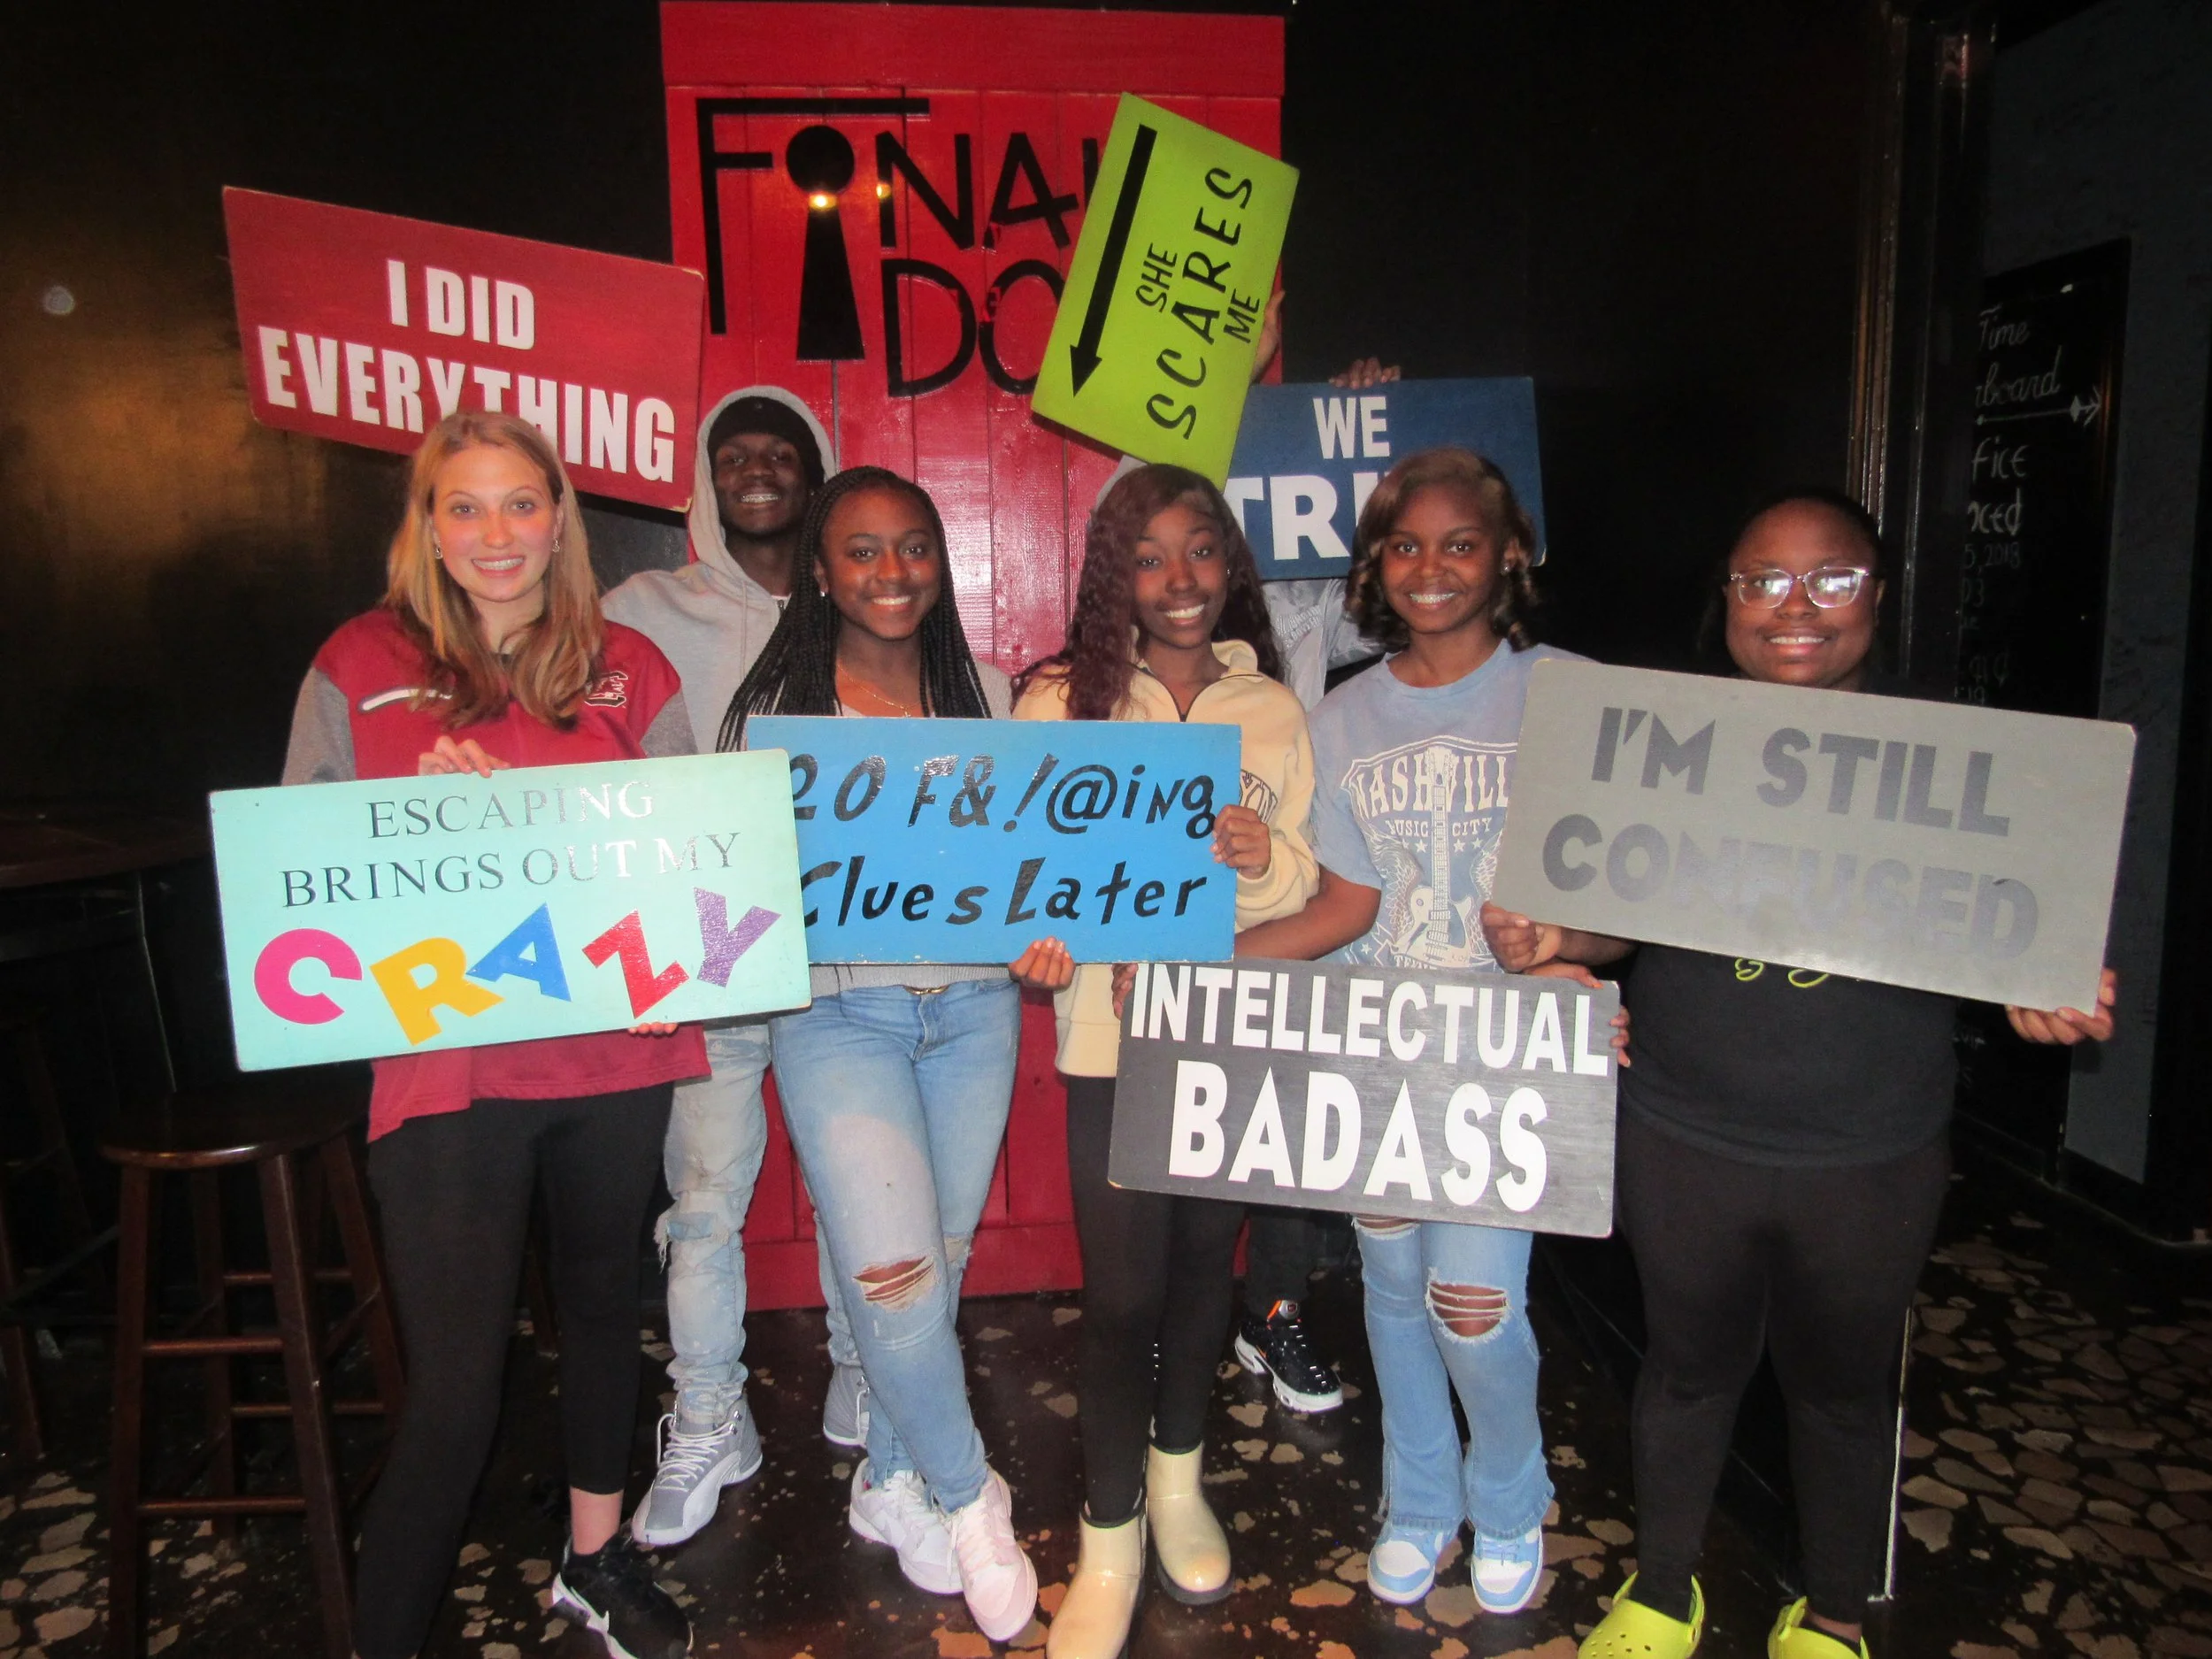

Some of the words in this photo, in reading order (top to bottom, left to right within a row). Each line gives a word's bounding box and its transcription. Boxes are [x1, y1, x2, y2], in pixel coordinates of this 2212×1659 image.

[388, 259, 408, 326] I
[425, 267, 535, 349] DID
[1135, 242, 1177, 313] SHE
[1146, 166, 1253, 440] SCARES
[1224, 288, 1260, 343] ME
[880, 258, 1065, 396] DO
[258, 325, 674, 482] EVERYTHING
[1313, 396, 1391, 459] WE
[367, 780, 654, 839] ESCAPING
[791, 753, 886, 821] 20
[1354, 752, 1509, 819] NASHVILL
[1591, 707, 1716, 795] I'M
[1755, 726, 2009, 836] STILL
[1452, 818, 1493, 837] CITY
[281, 852, 504, 908] BRINGS
[522, 840, 636, 886] OUT
[653, 833, 741, 874] MY
[800, 856, 989, 927] Clues
[1004, 857, 1207, 926] Later
[1542, 813, 2039, 959] CONFUSED
[253, 887, 781, 1046] CRAZY
[1131, 962, 1609, 1076] INTELLECTUAL
[1168, 1060, 1548, 1211] BADASS
